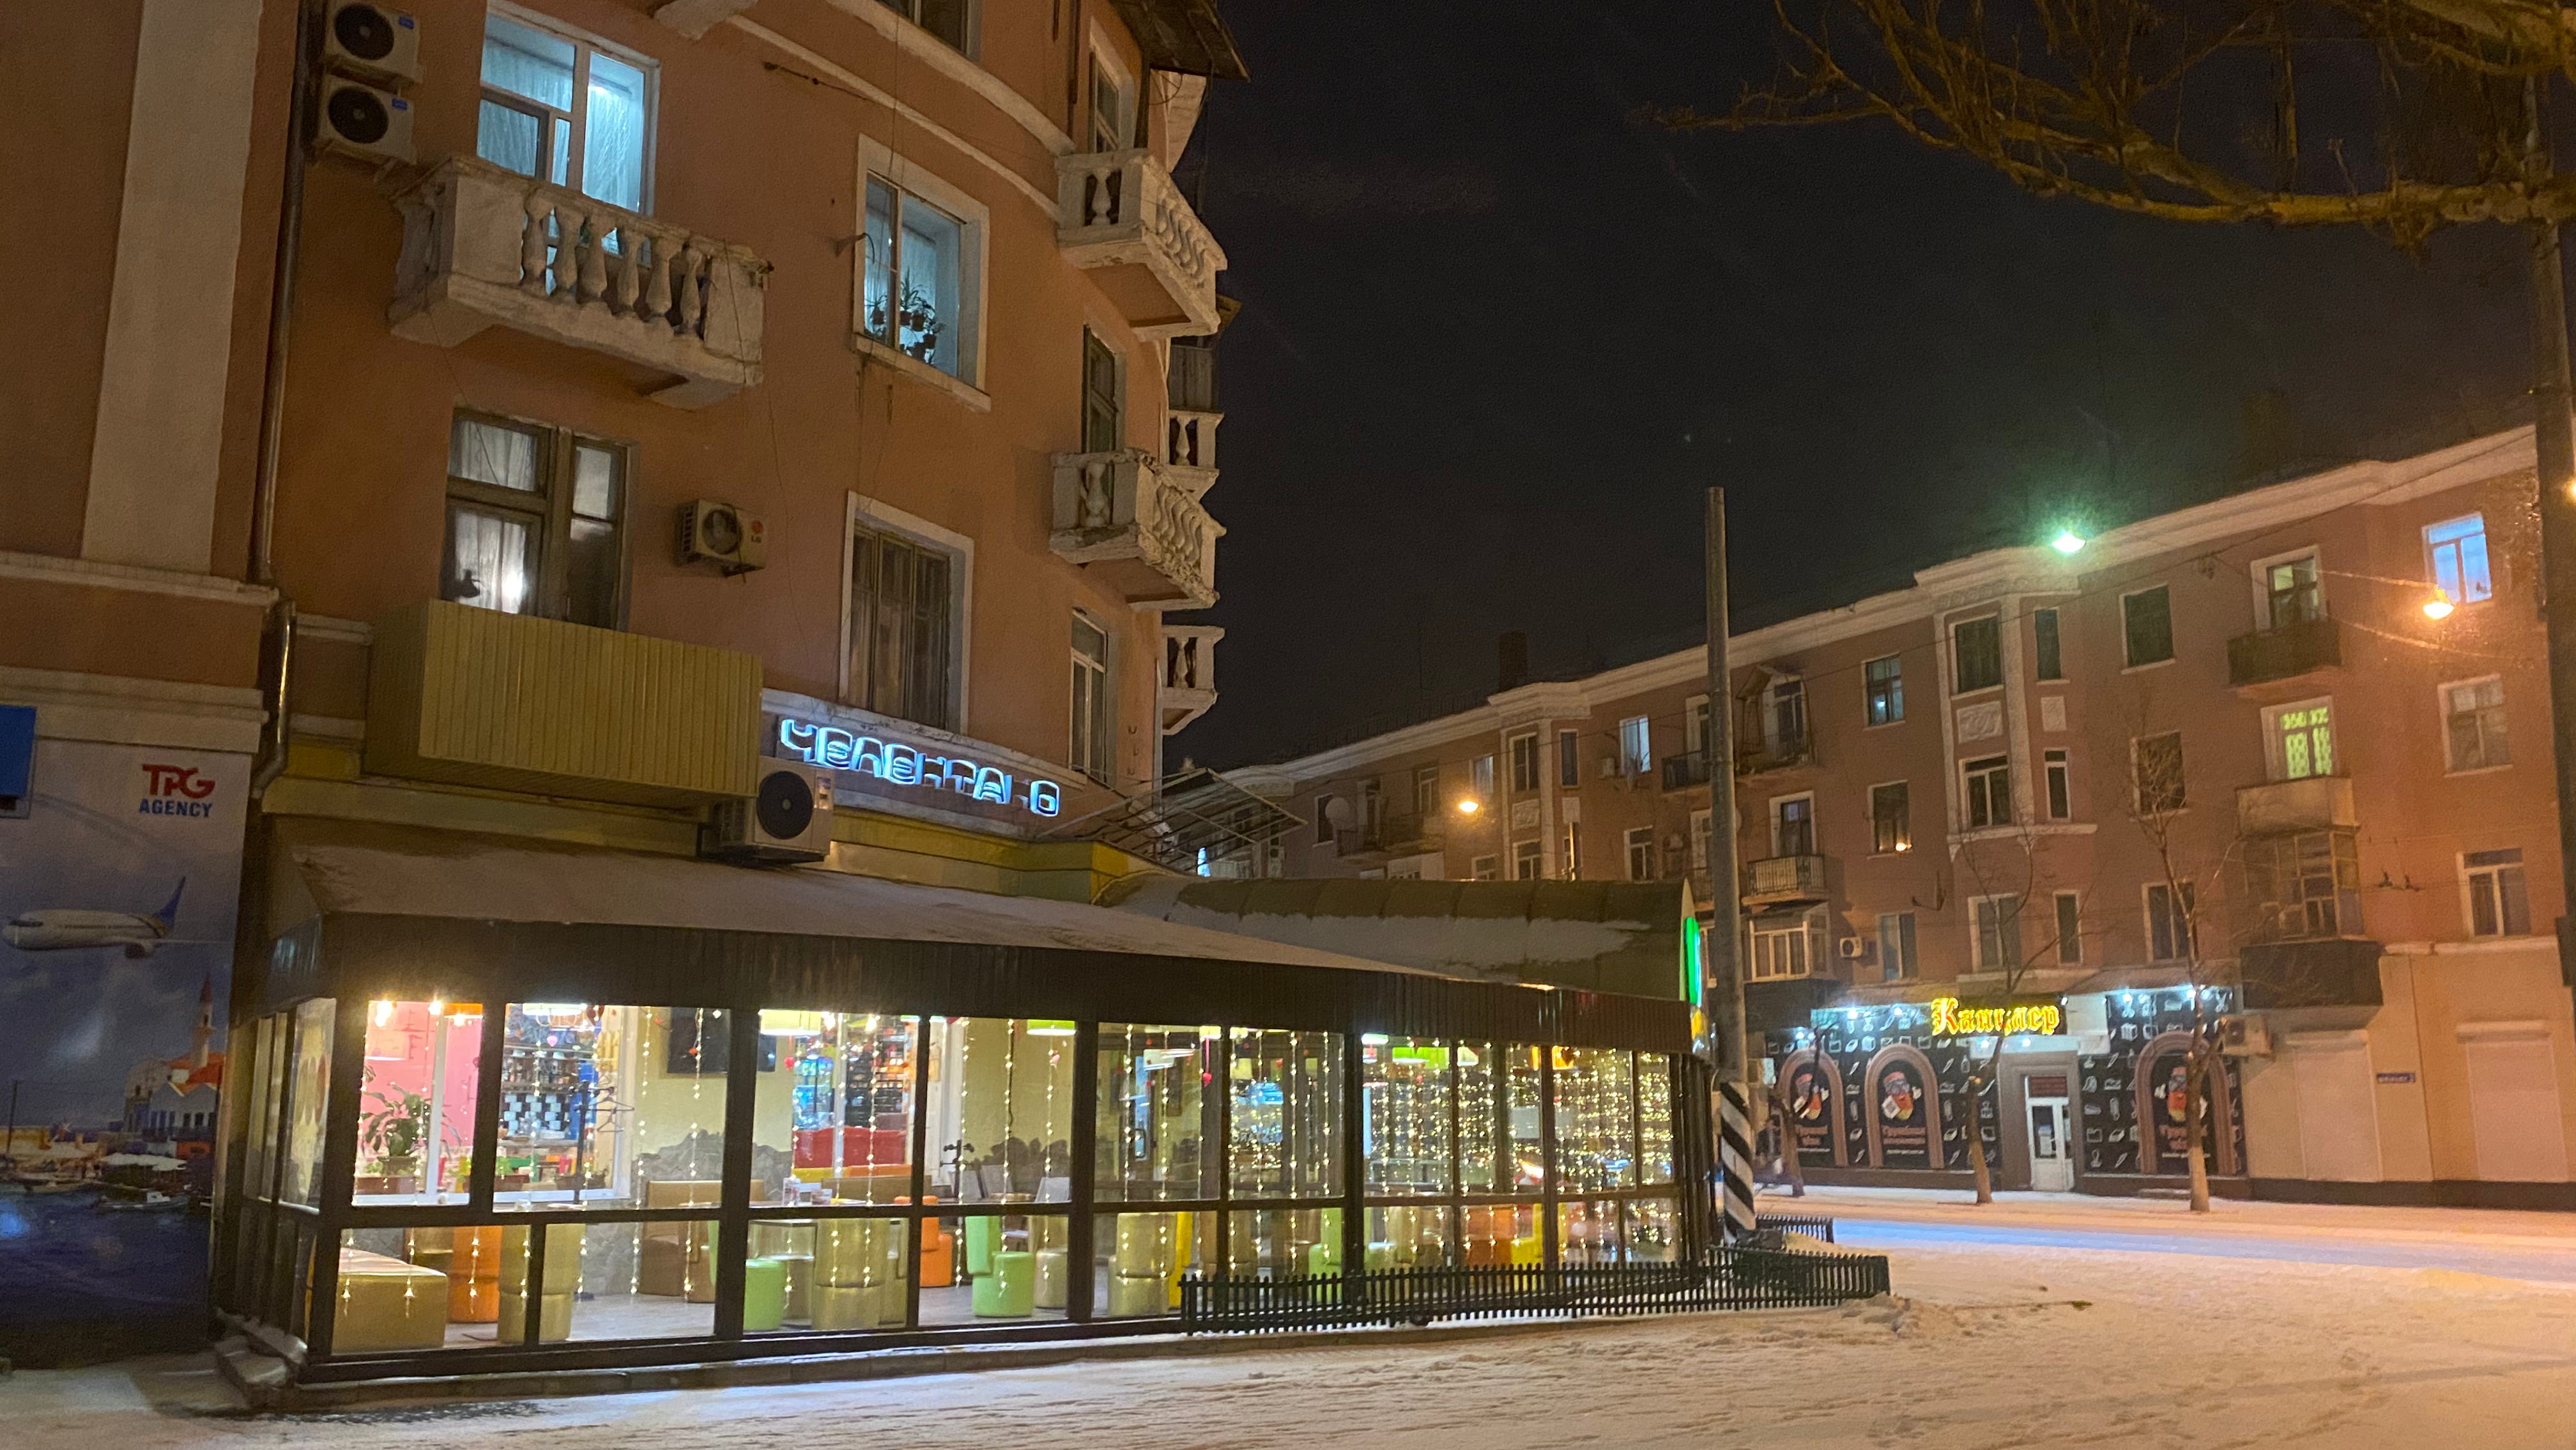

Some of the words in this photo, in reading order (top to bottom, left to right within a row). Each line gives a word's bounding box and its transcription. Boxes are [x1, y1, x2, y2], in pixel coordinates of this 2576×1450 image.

[141, 763, 215, 799] TPG
[139, 798, 213, 818] AGENCY
[1931, 997, 2060, 1037] Канцлер
